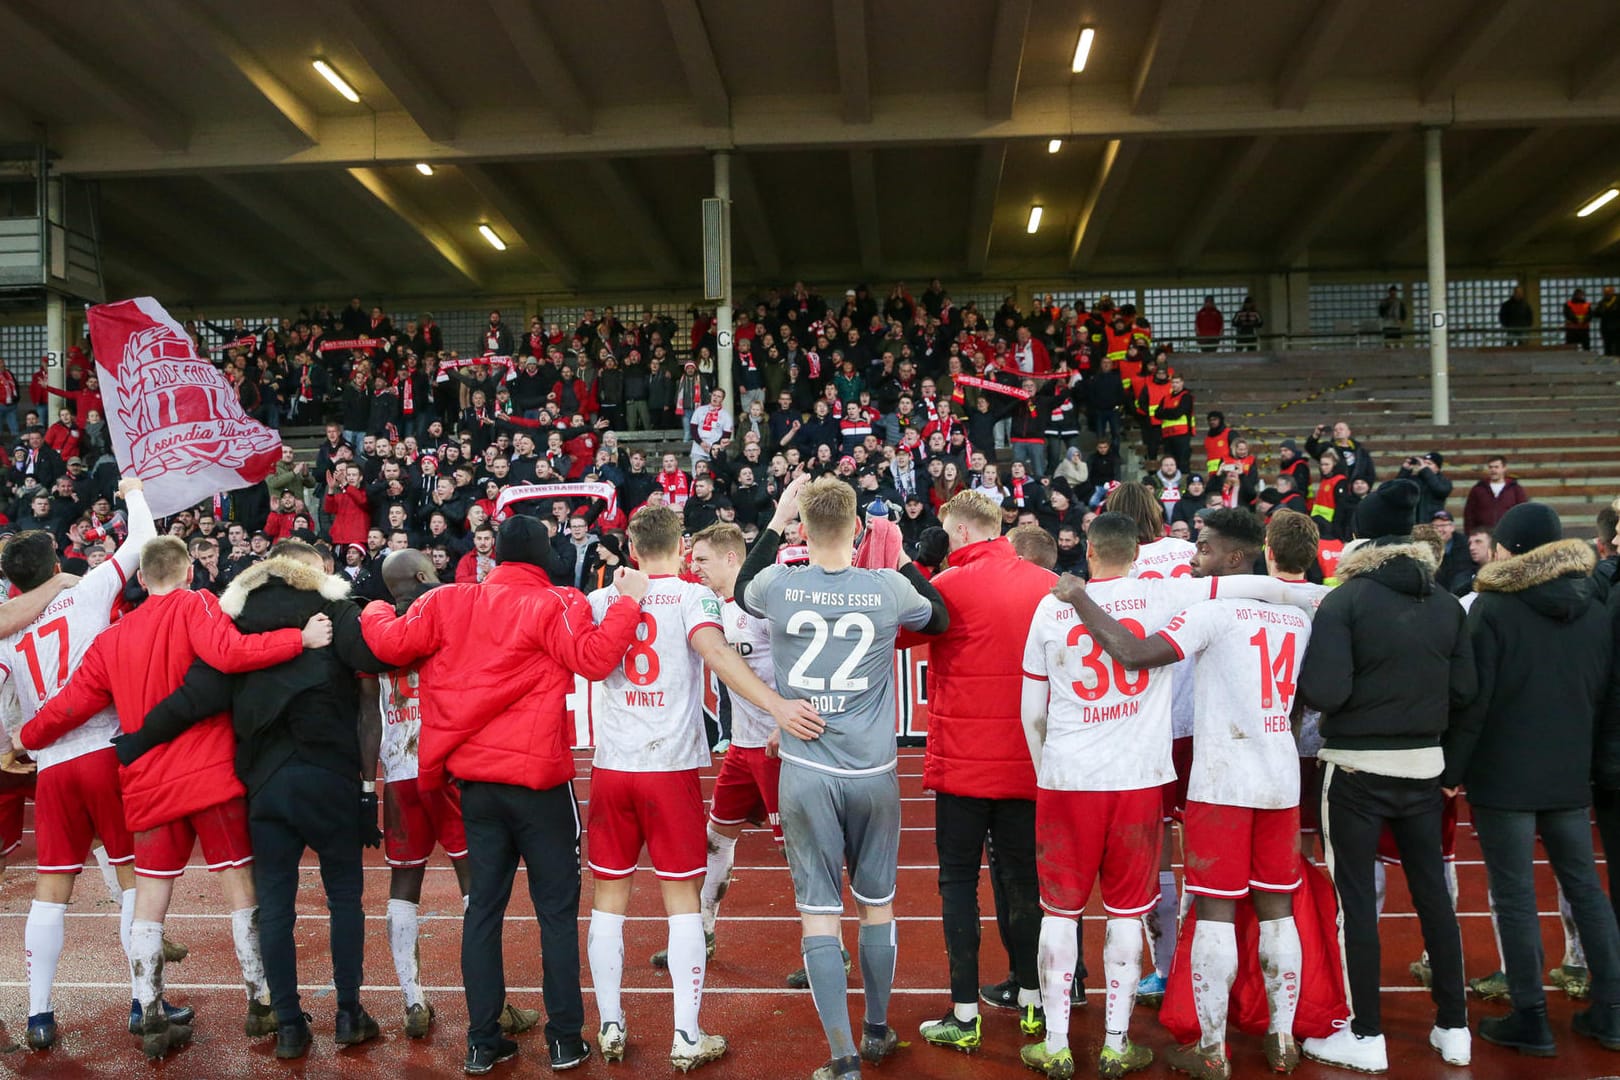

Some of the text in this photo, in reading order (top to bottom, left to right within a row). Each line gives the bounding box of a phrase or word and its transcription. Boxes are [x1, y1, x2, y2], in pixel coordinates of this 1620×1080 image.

[1432, 312, 1445, 328] D
[718, 331, 731, 347] C
[47, 352, 57, 367] B
[47, 596, 75, 615] ESSEN
[656, 594, 681, 605] ESSEN
[785, 588, 881, 606] ROT-WEISS ESSEN
[1115, 598, 1147, 612] ESSEN
[624, 612, 660, 686] 8
[786, 610, 875, 691] 22
[15, 616, 70, 701] 17
[1249, 627, 1296, 712] 14
[625, 691, 665, 707] WIRTZ
[811, 695, 846, 713] GOLZ
[1083, 700, 1139, 723] DAHMAN
